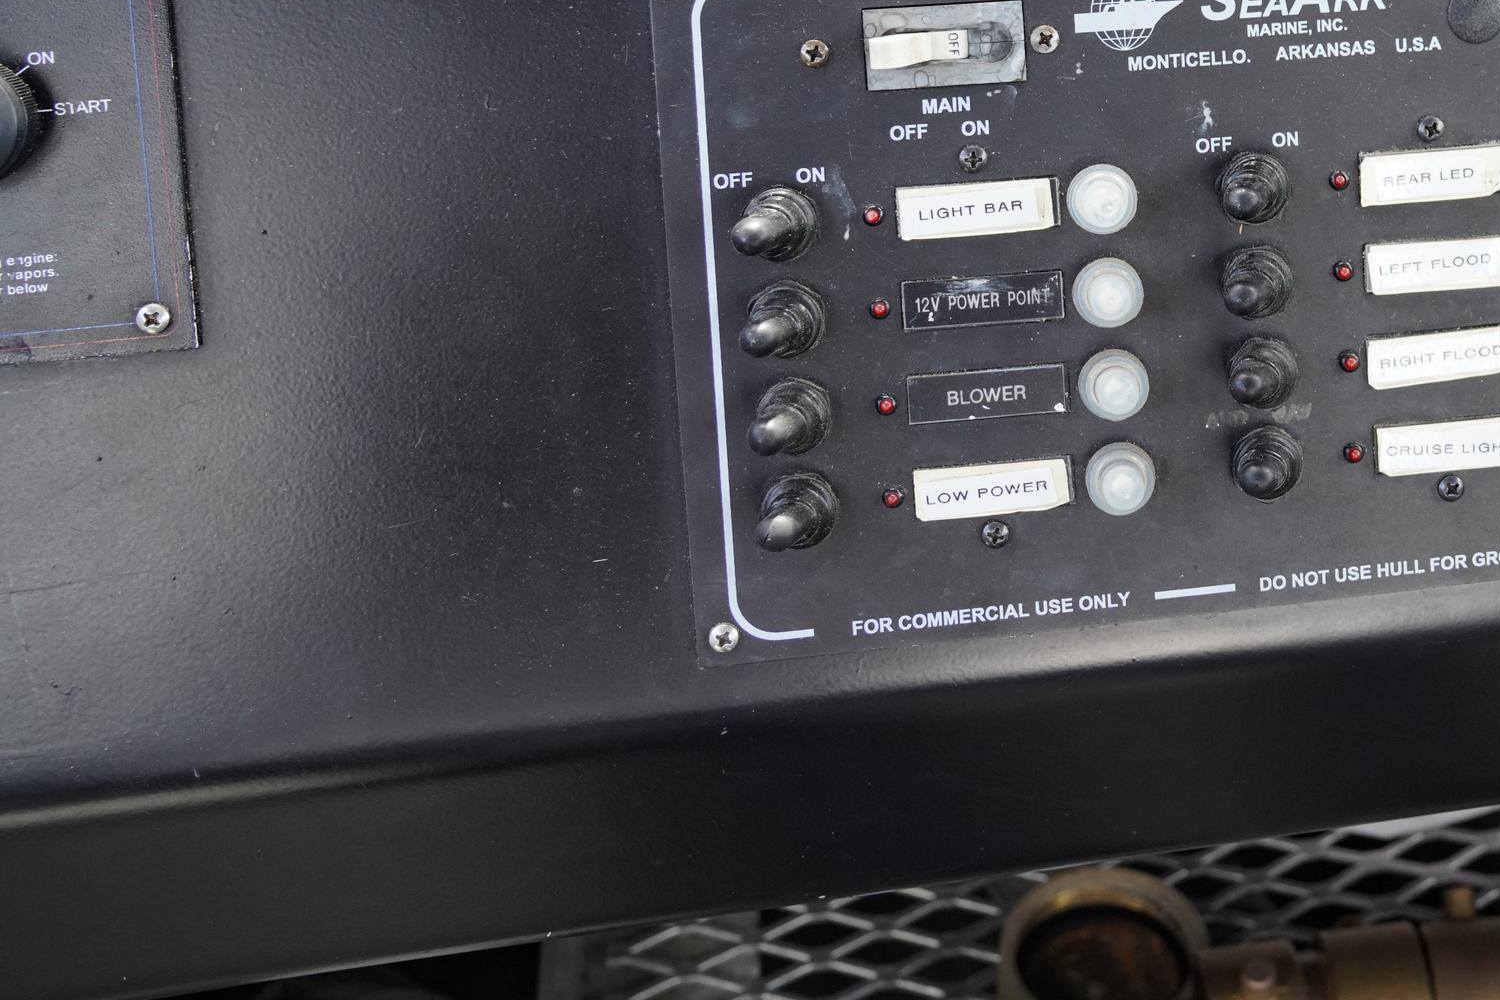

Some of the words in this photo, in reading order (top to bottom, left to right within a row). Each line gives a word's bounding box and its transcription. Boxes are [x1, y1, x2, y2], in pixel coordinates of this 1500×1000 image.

[1247, 21, 1312, 37] MARINE,
[1317, 18, 1347, 32] INC.
[947, 32, 961, 56] OFF
[1128, 49, 1250, 71] MONTICELLO.
[1276, 40, 1375, 60] ARKANSAS
[1396, 36, 1441, 52] U.S.A
[27, 50, 56, 66] ON
[54, 98, 112, 117] START
[922, 96, 970, 114] MAIN
[890, 124, 928, 141] OFF
[962, 120, 989, 136] ON
[1196, 137, 1232, 153] OFF
[1272, 132, 1298, 147] ON
[714, 172, 752, 189] OFF
[796, 167, 825, 183] ON
[1384, 173, 1431, 185] REAR
[1440, 168, 1473, 180] LED
[919, 205, 974, 220] LIGHT
[985, 201, 1022, 213] BAR
[6, 252, 59, 267] engine:
[1379, 262, 1422, 275] LEFT
[1432, 254, 1489, 269] FLOOD
[7, 283, 49, 295] below
[914, 295, 940, 312] 12V
[948, 291, 1000, 311] POWER
[1008, 287, 1050, 307] POINT
[1380, 353, 1434, 368] RIGHT
[946, 385, 1027, 407] BLOWER
[1387, 444, 1453, 456] CRUISE
[927, 491, 968, 505] LOW
[978, 481, 1047, 498] POWER
[1260, 575, 1286, 591] DO
[1292, 570, 1329, 587] NOT
[1335, 565, 1371, 582] USE
[1377, 560, 1425, 577] HULL
[1430, 555, 1467, 571] FOR
[853, 618, 893, 635] FOR
[899, 603, 1030, 630] COMMERCIAL
[1036, 598, 1073, 615] USE
[1079, 592, 1130, 610] ONLY
